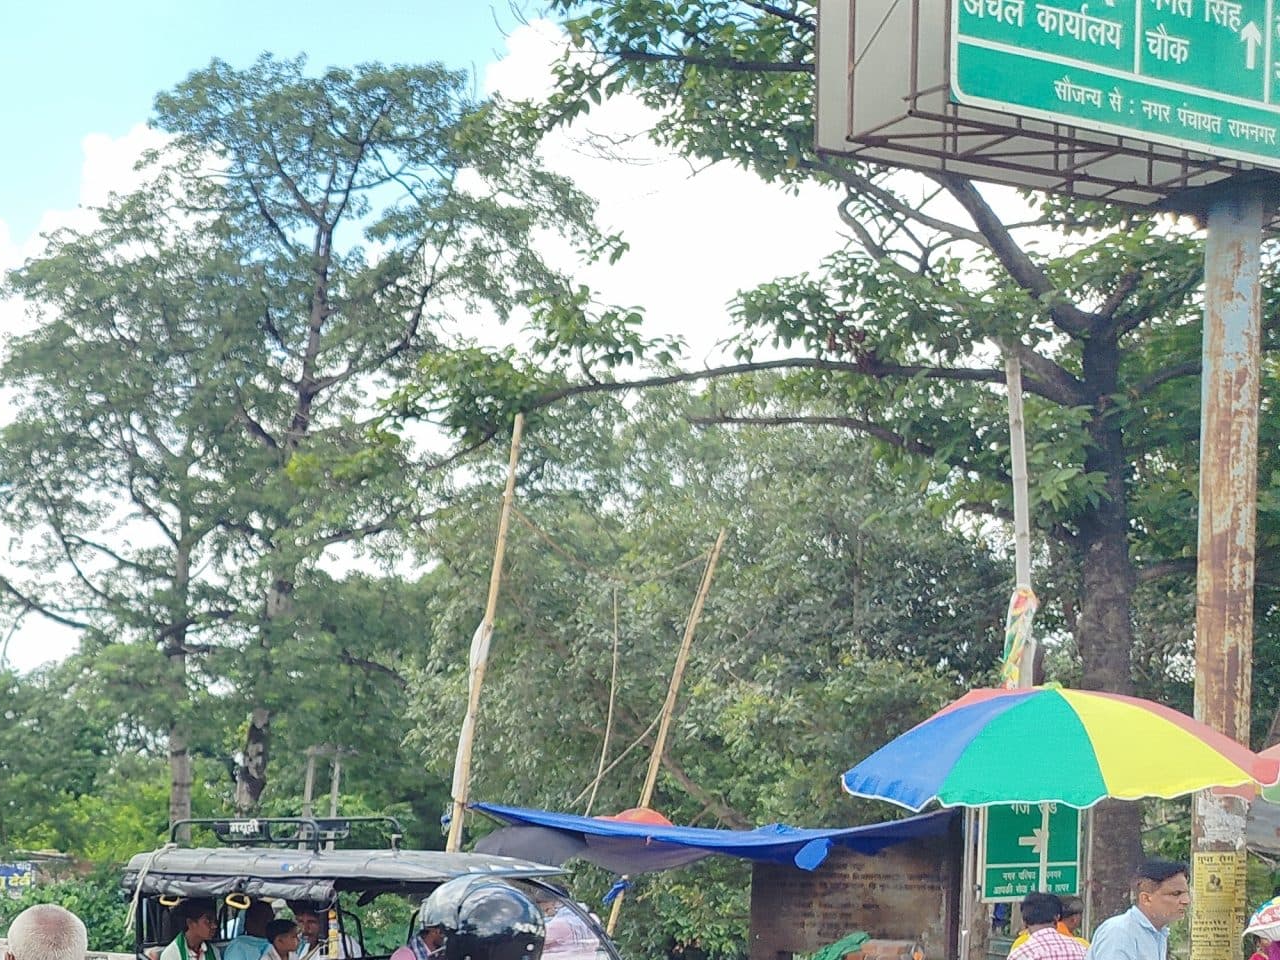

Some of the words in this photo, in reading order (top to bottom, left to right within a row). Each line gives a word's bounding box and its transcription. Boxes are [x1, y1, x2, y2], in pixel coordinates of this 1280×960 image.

[1035, 3, 1122, 50] कार्यालय
[1145, 22, 1190, 65] चौक
[1054, 75, 1102, 108] सौजन्य
[1108, 86, 1122, 112] से
[1141, 99, 1171, 123] नगर
[1177, 102, 1222, 134] पंचायत
[1227, 117, 1276, 145] रामनगर
